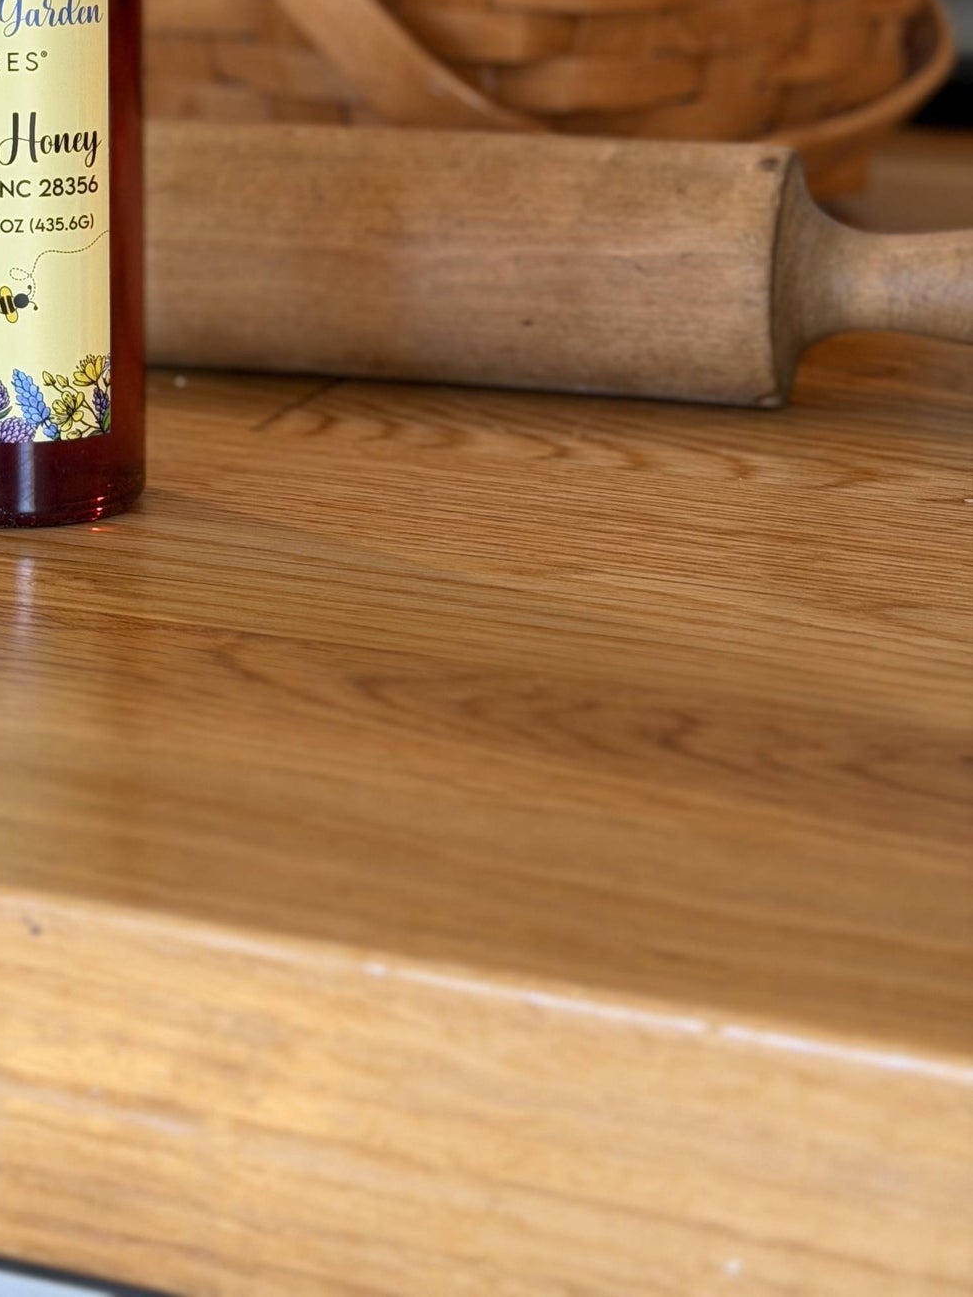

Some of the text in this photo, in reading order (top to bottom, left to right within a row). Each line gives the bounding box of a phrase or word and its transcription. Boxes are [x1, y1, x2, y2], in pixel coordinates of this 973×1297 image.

[0, 179, 32, 198] NC
[38, 174, 99, 198] 28356
[29, 213, 95, 234] (435.6G)
